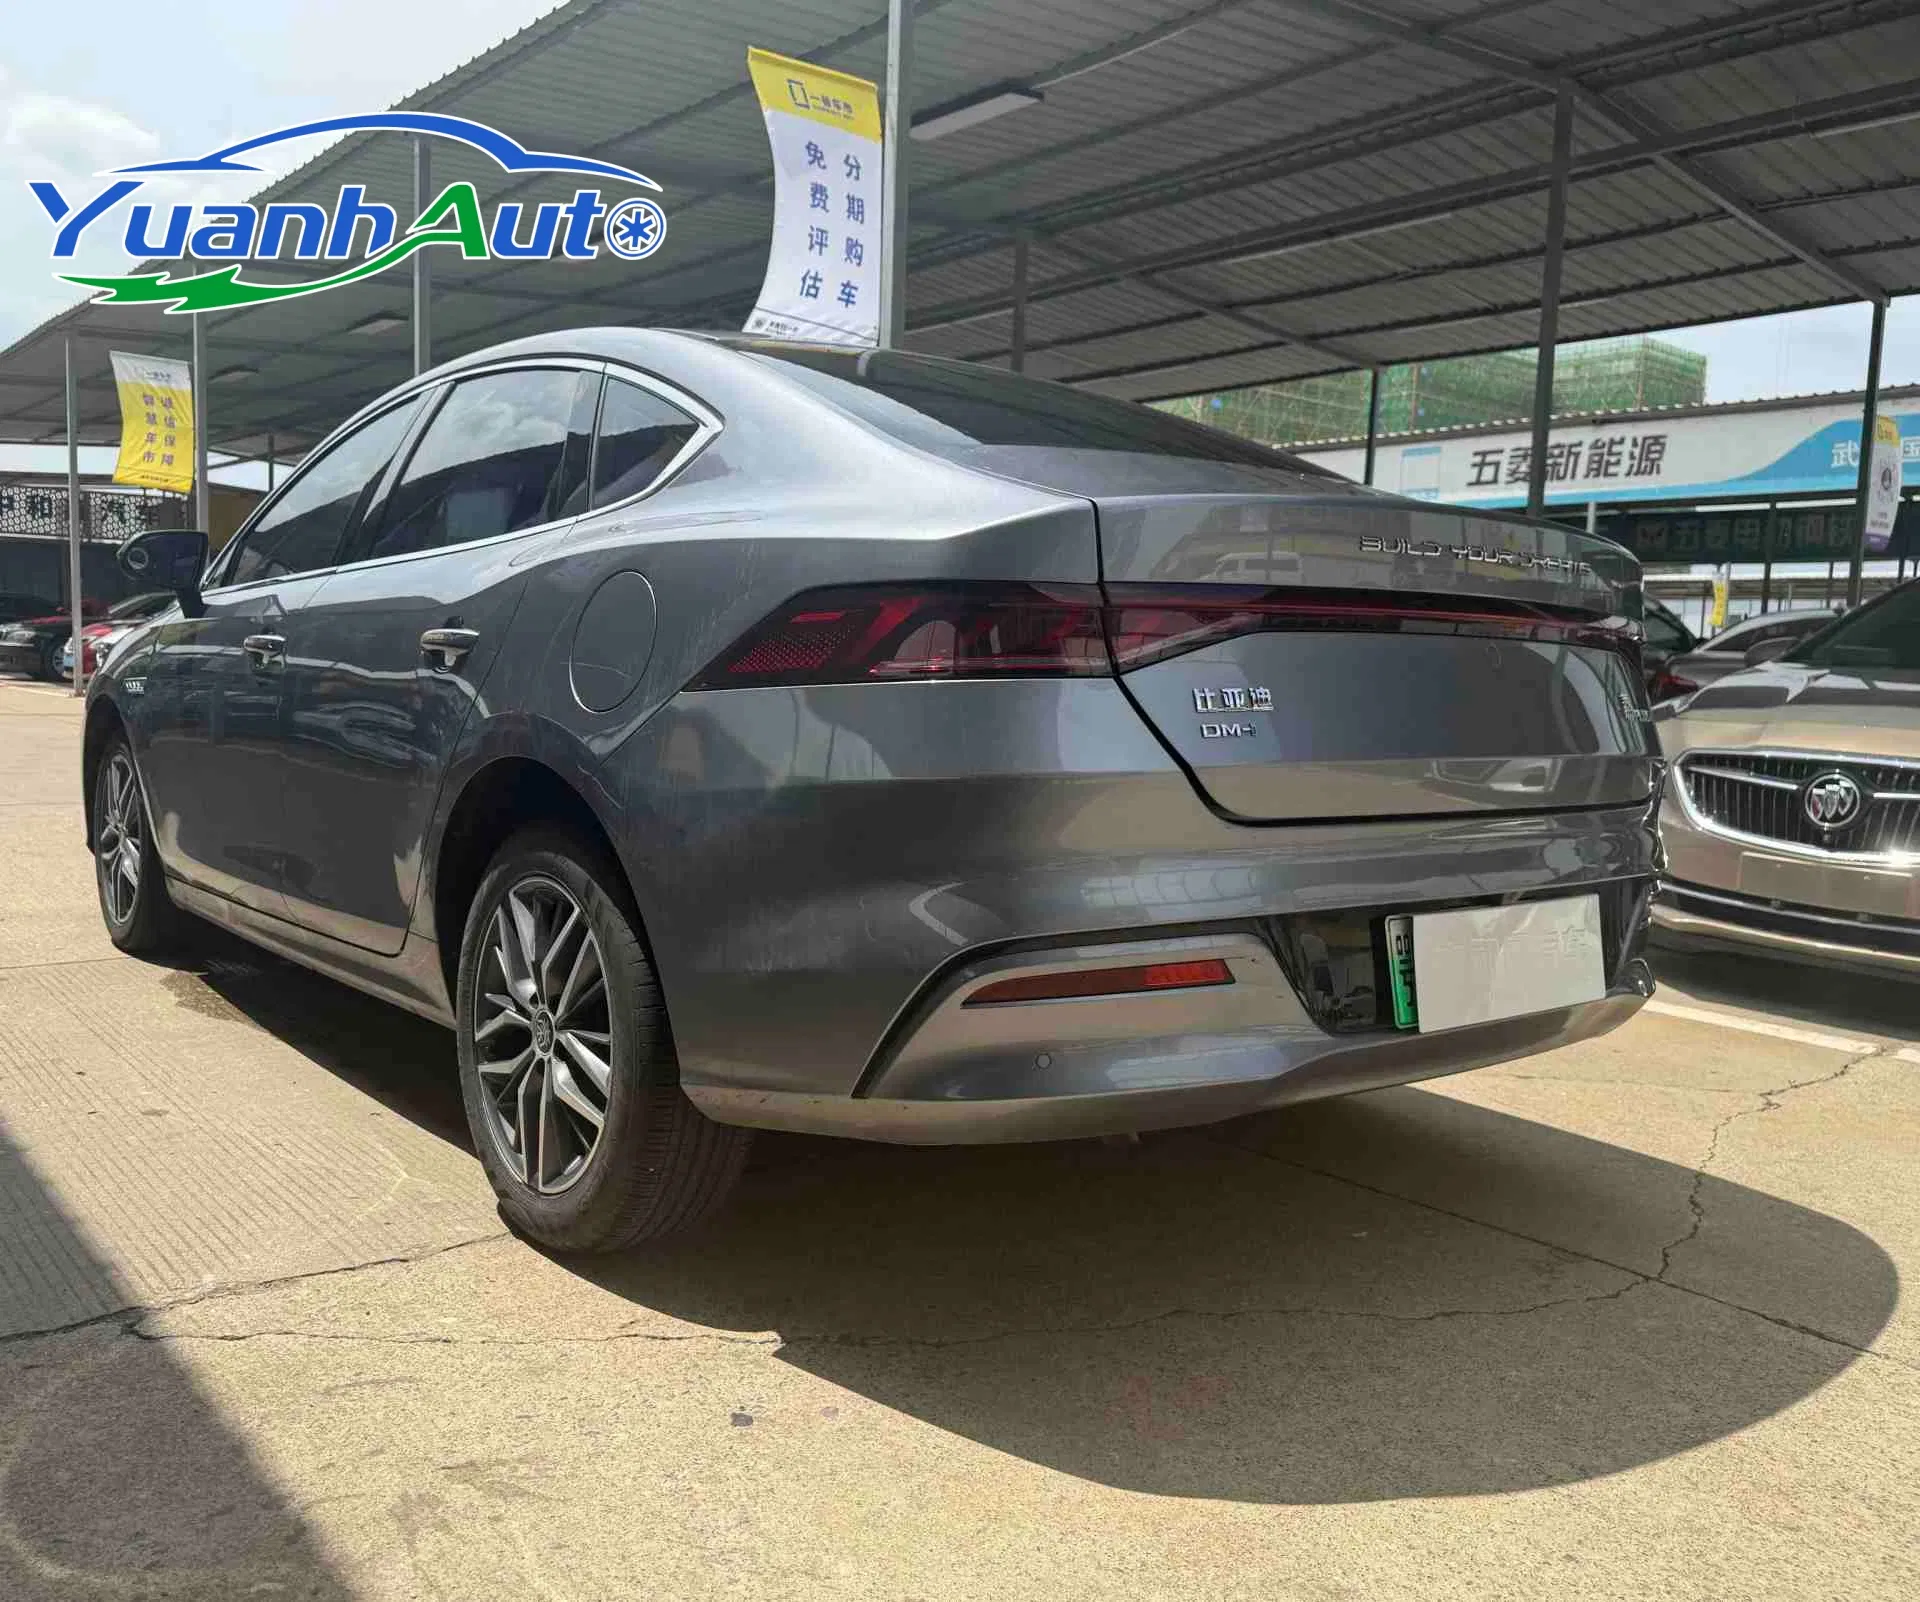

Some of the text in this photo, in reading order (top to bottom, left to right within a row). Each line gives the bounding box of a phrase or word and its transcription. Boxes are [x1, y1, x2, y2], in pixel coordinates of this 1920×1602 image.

[800, 140, 830, 300] 免费评估
[837, 153, 866, 308] 分期购车
[1359, 535, 1442, 557] BUILD
[1450, 543, 1514, 564] YOUR
[1192, 686, 1275, 713] 比亚迪
